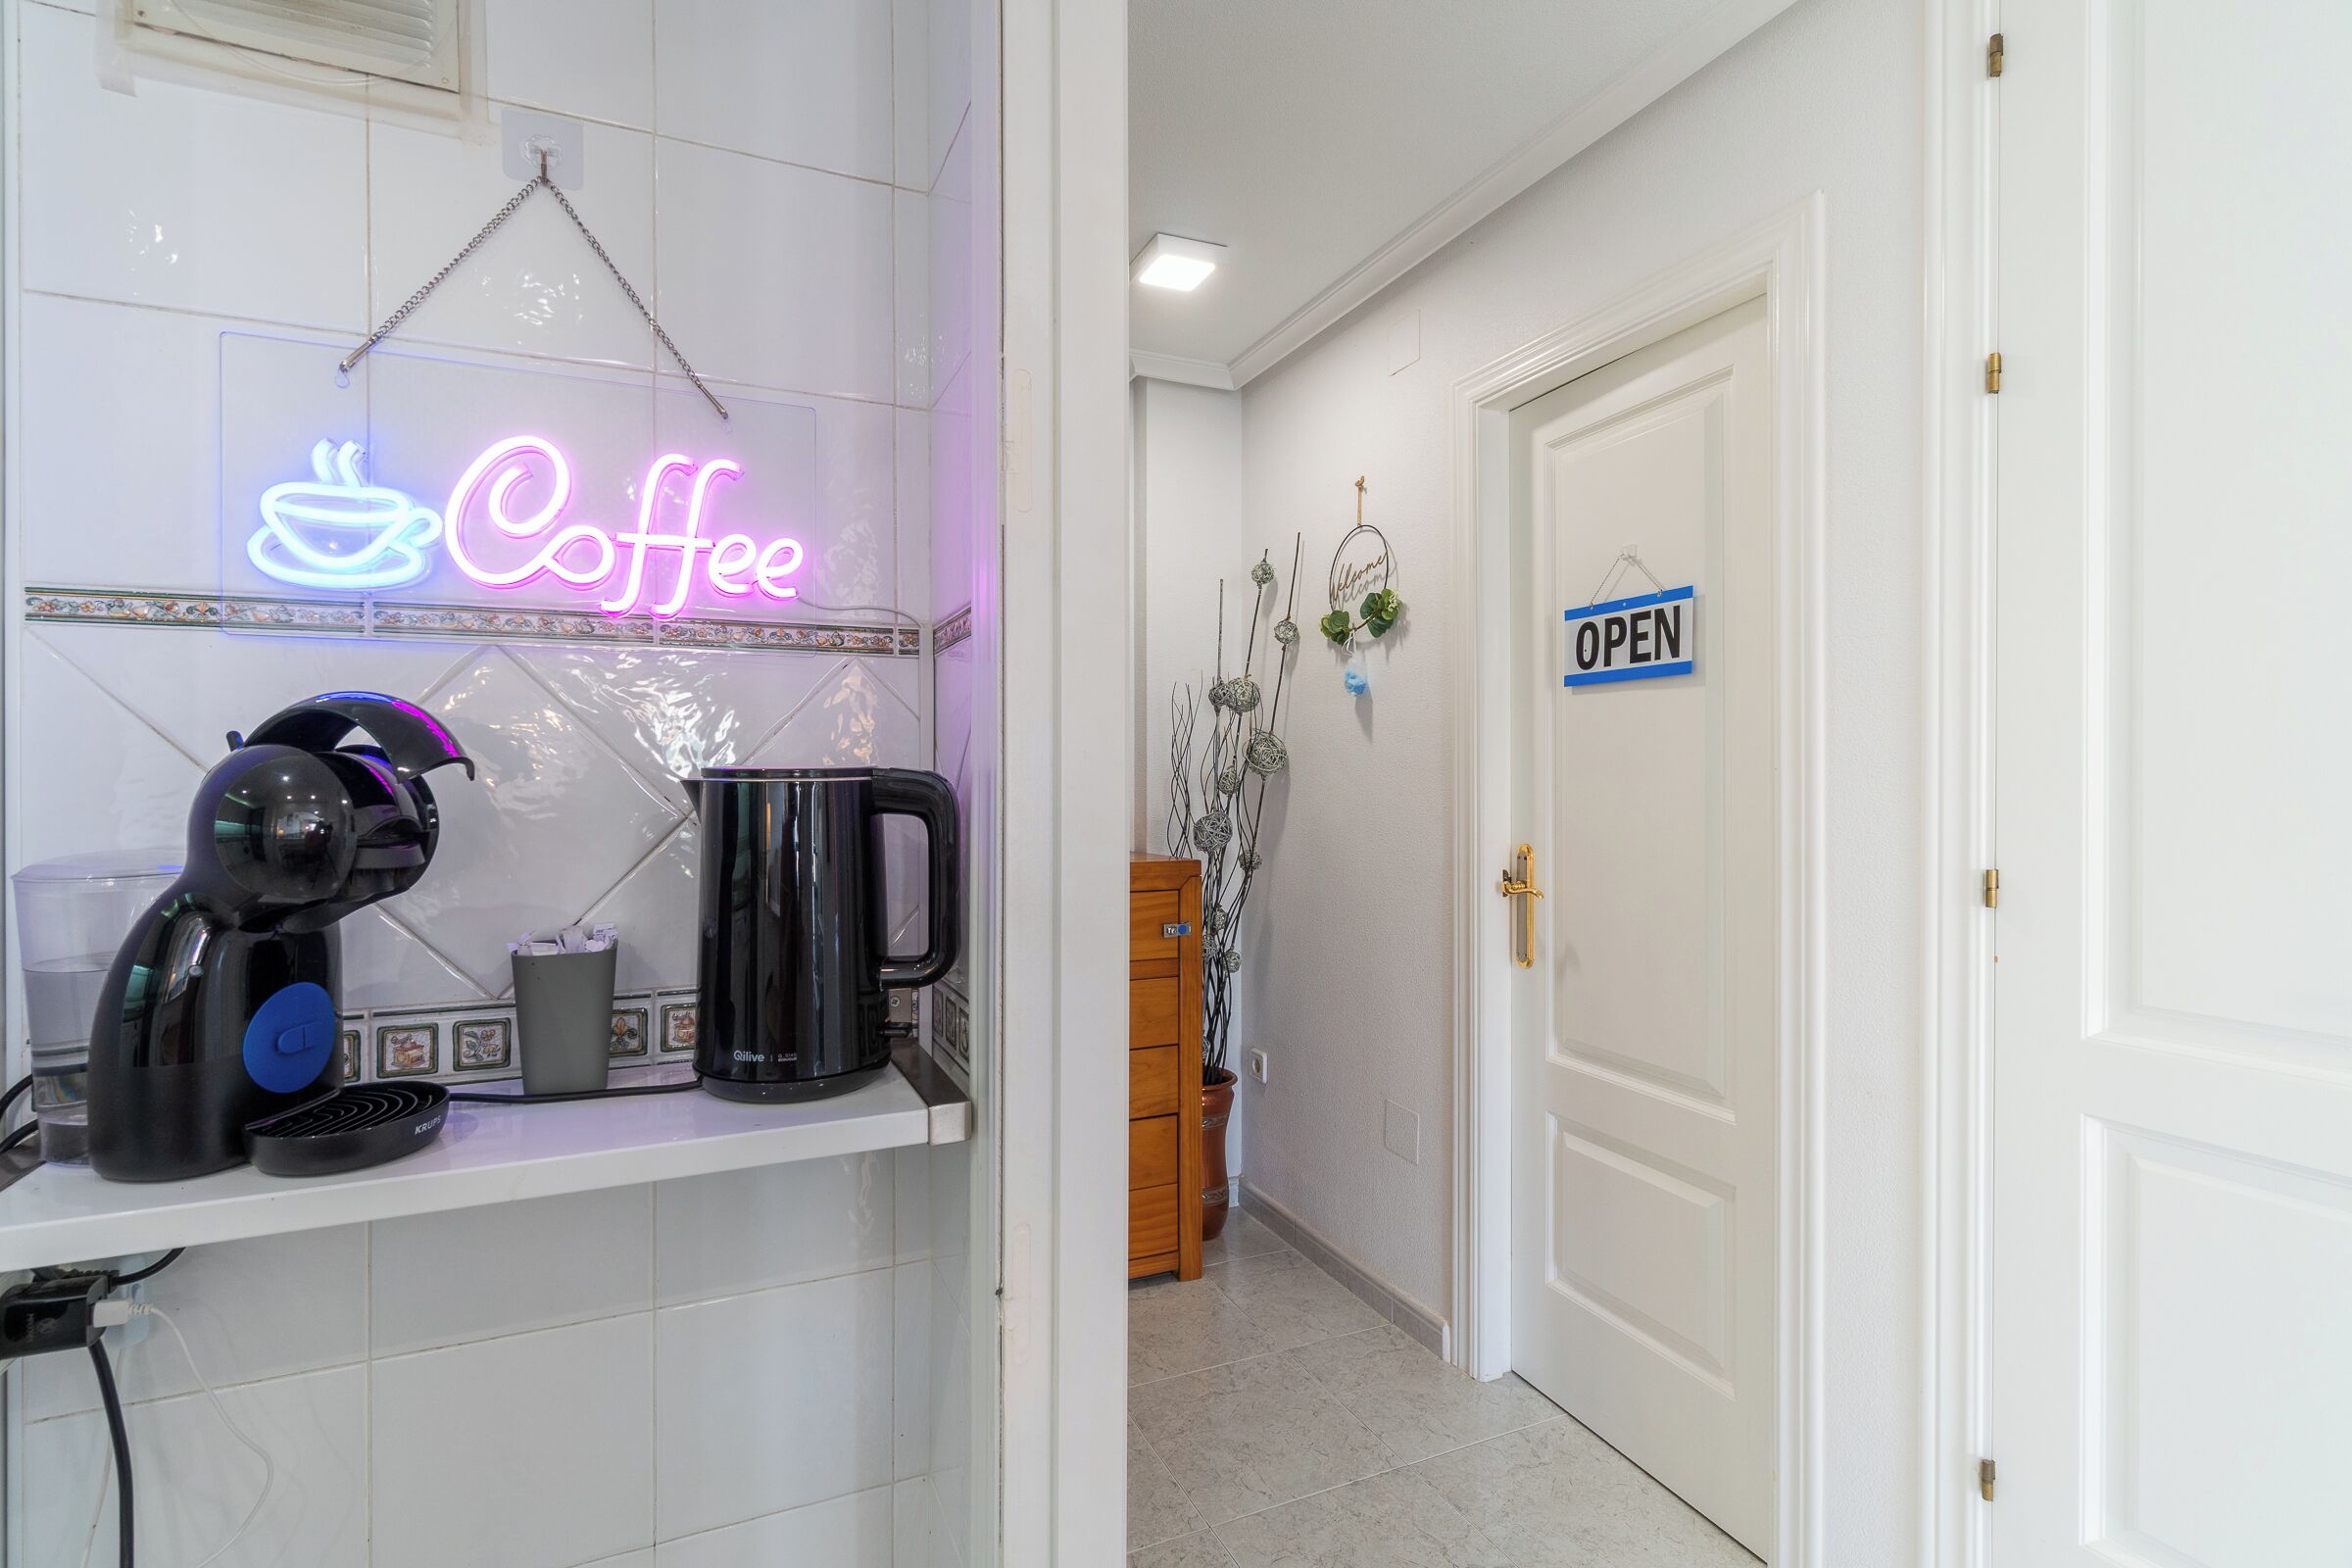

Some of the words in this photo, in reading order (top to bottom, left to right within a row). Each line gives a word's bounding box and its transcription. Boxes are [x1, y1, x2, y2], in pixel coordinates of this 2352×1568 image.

[444, 434, 806, 619] Coffee
[1576, 604, 1681, 671] OPEN
[733, 1050, 765, 1062] Qilive
[415, 1115, 442, 1135] KRUPS
